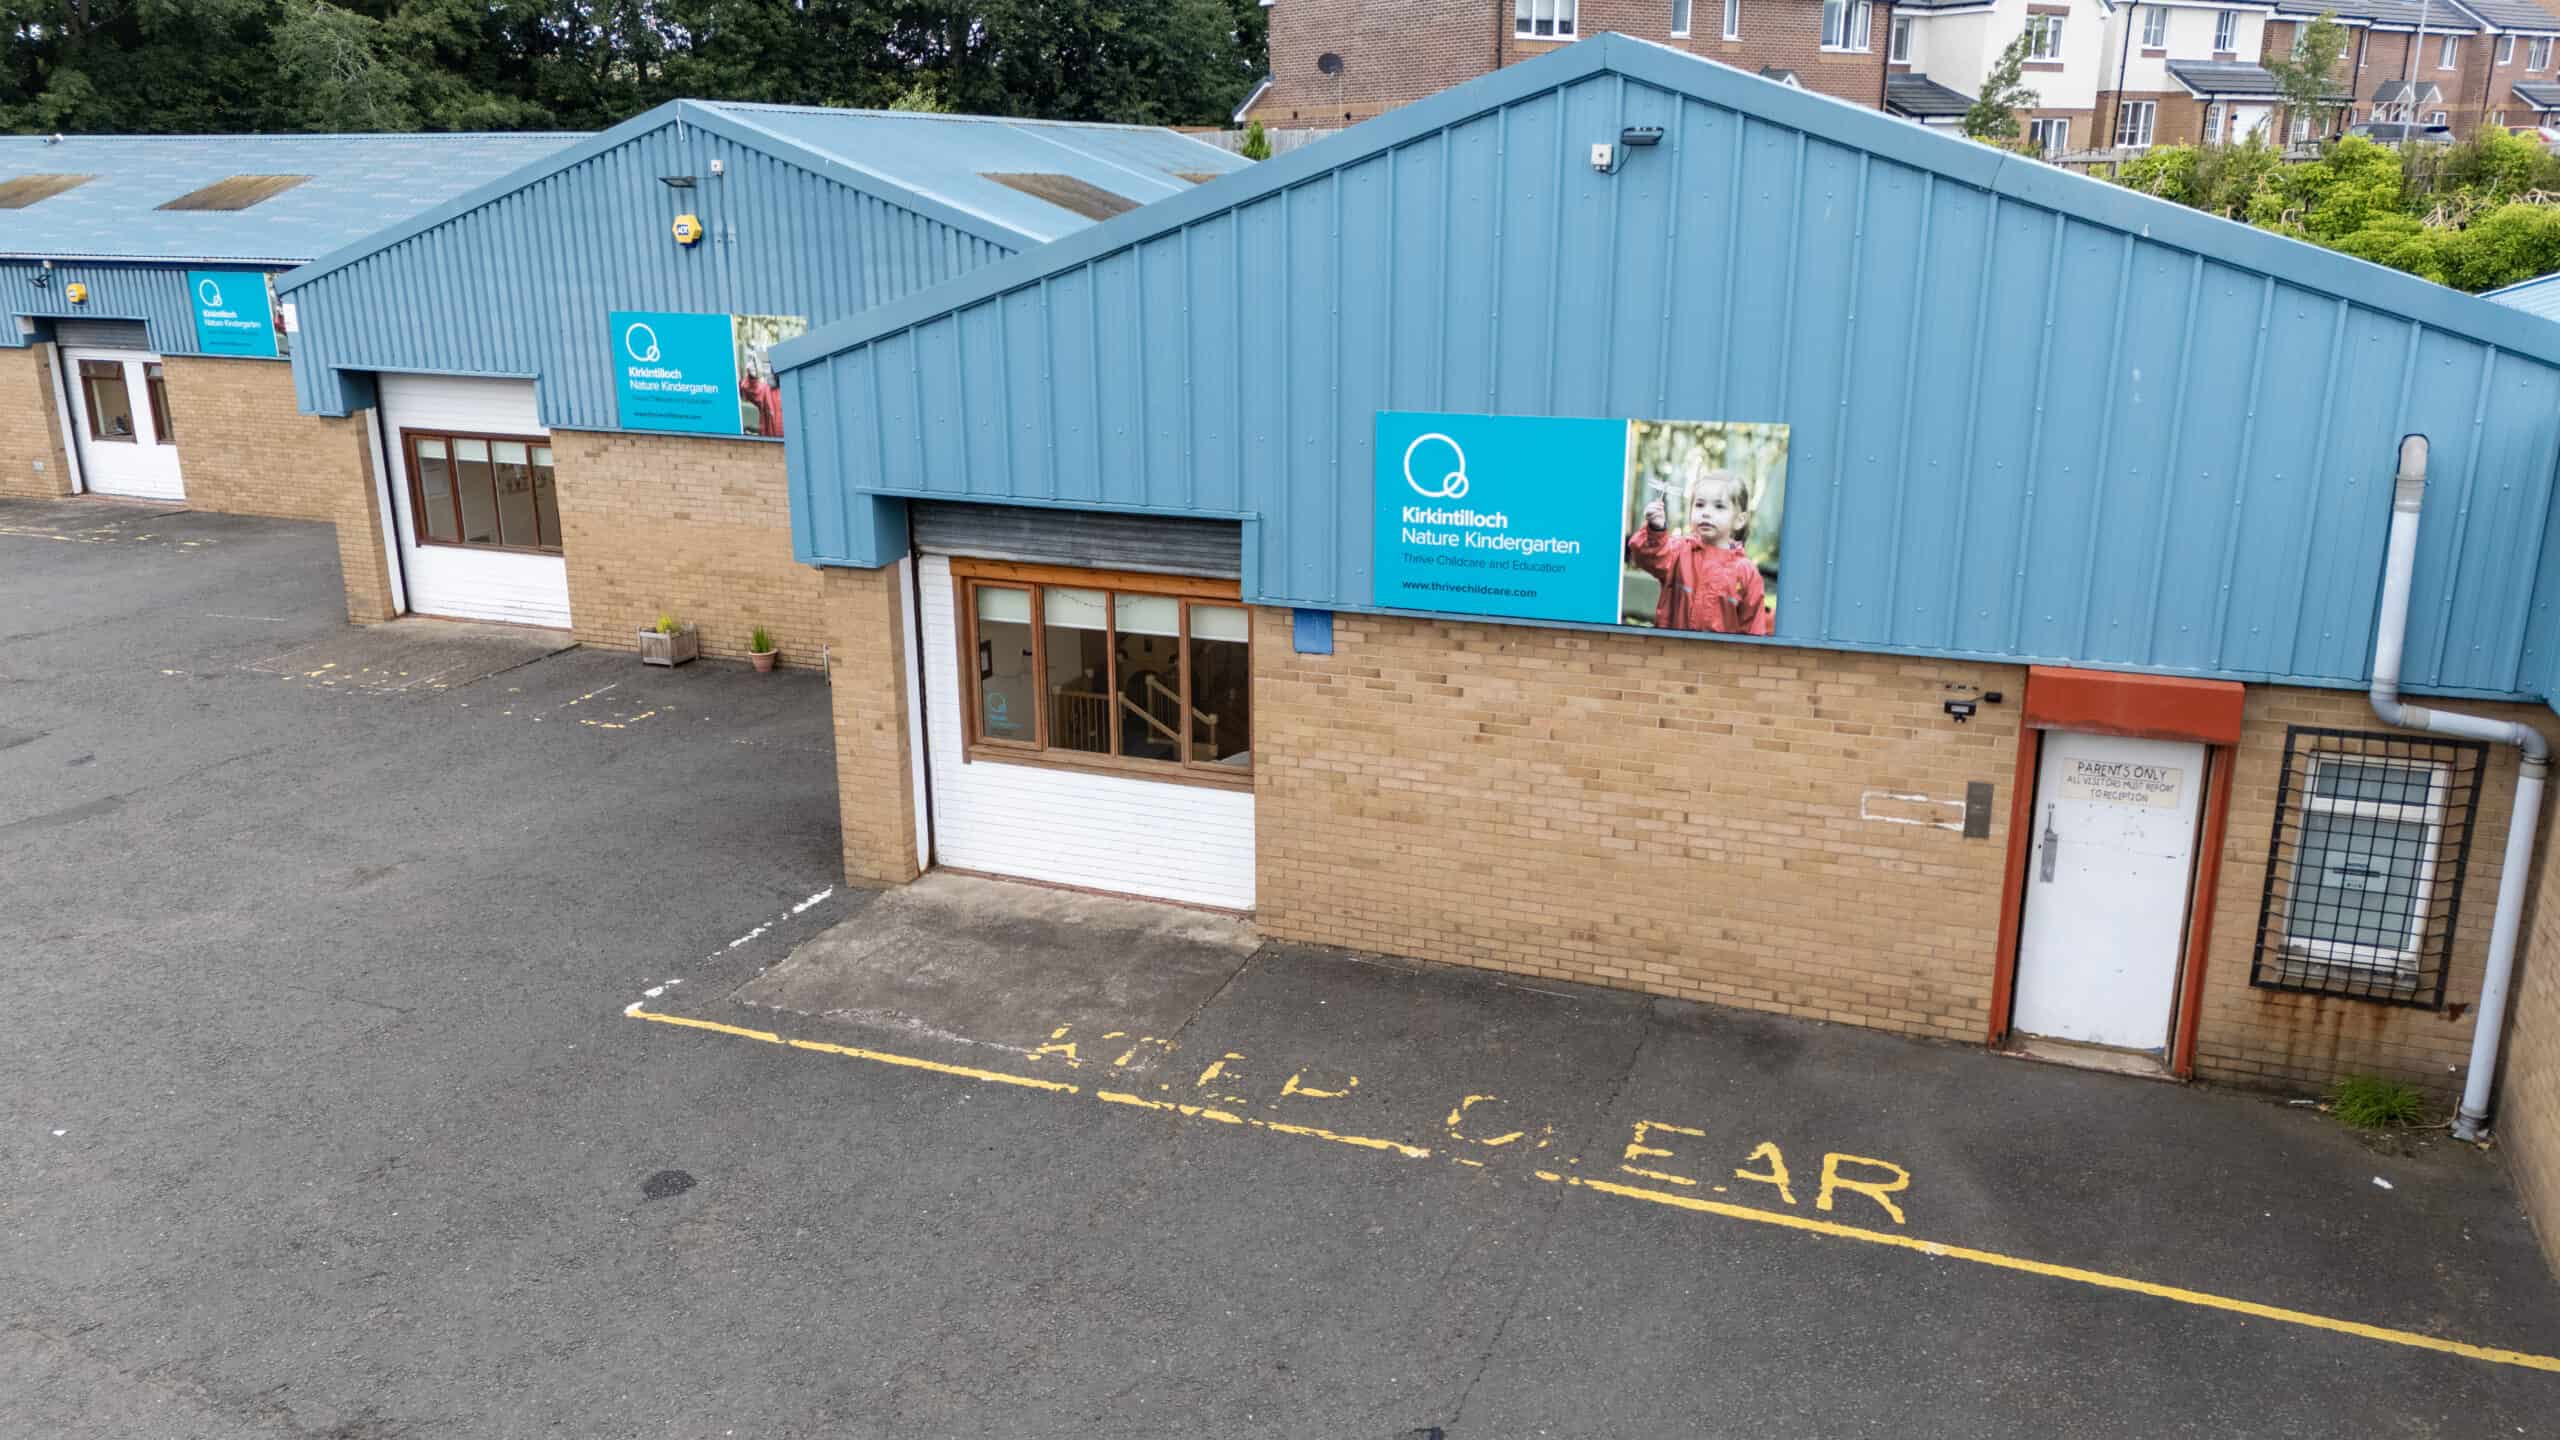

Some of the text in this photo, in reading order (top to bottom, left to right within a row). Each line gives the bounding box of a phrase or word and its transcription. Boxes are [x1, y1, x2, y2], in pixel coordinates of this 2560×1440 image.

[1402, 506, 1508, 528] Kirkintilloch
[1402, 527, 1580, 555] Nature Kindergarten
[1402, 553, 1566, 573] Thrive Childcare and Education
[1402, 581, 1537, 598] www.thrivechildcare.com
[2134, 766, 2167, 782] ONLY
